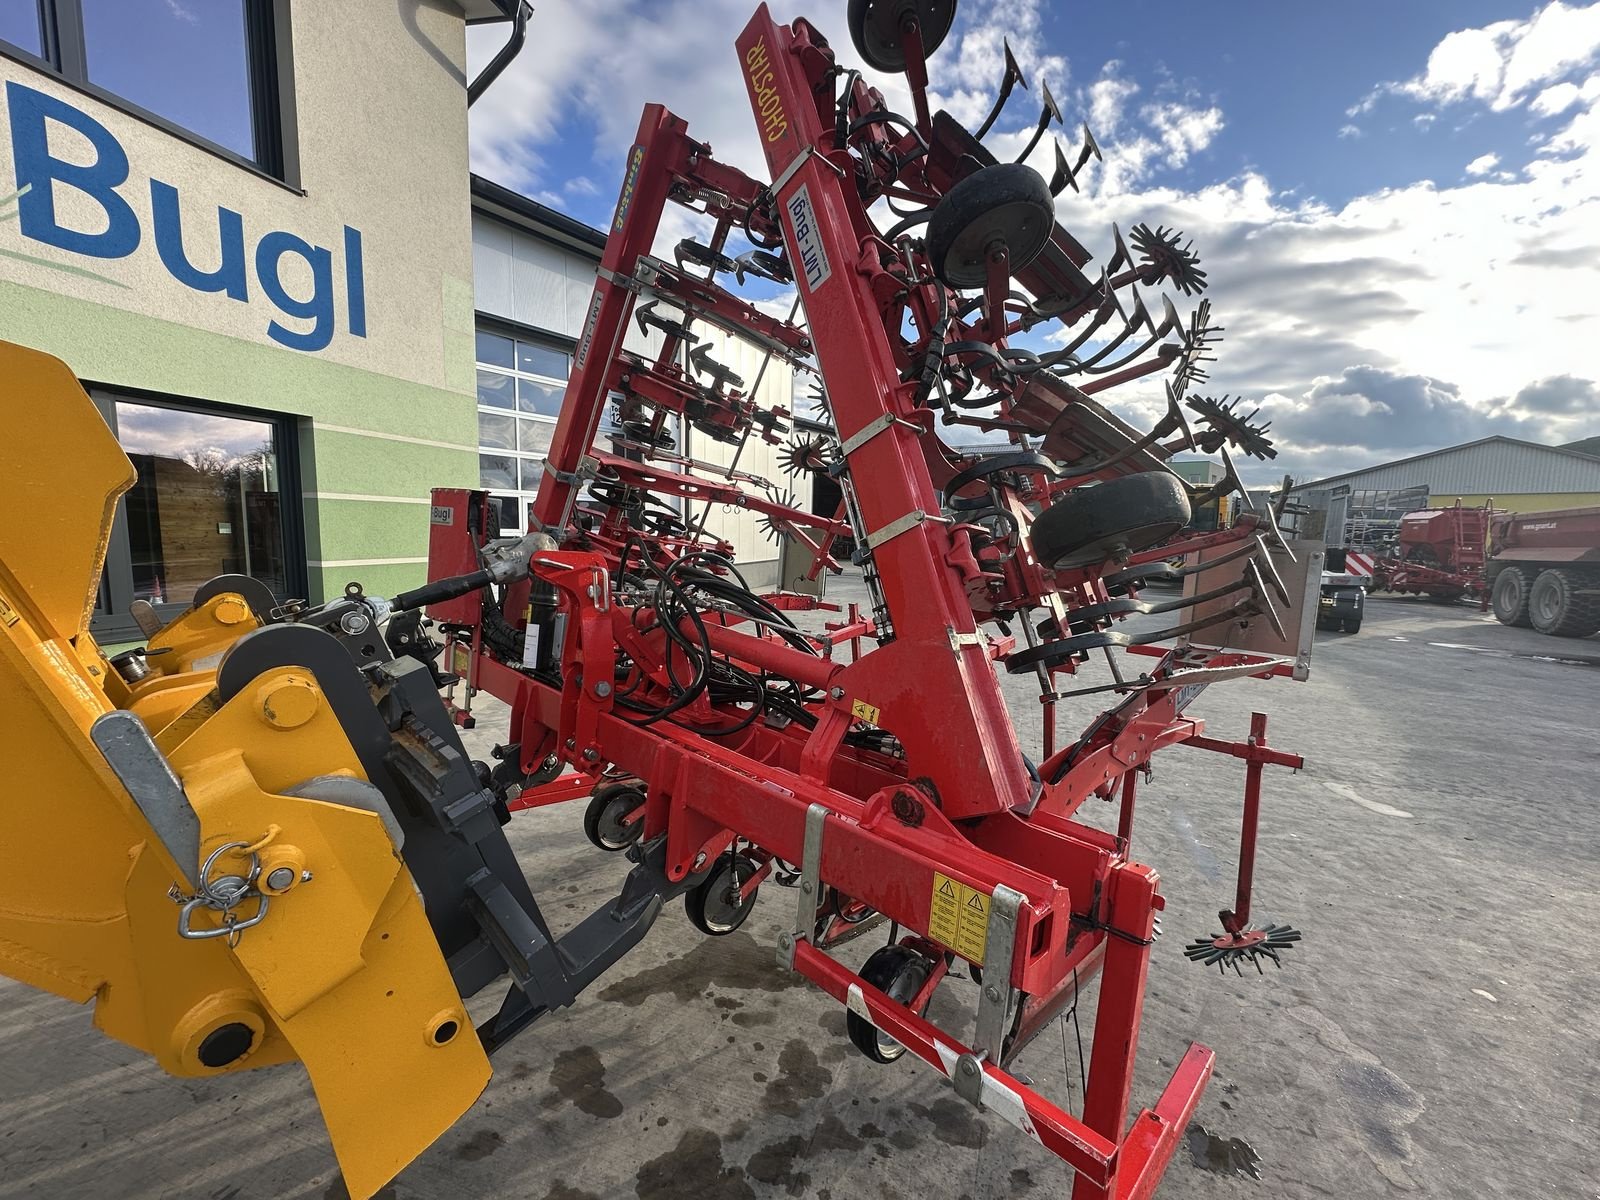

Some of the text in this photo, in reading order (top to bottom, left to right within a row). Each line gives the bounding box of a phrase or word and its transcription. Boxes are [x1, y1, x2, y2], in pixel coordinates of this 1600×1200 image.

[746, 34, 788, 142] CHOPSTAR
[6, 80, 367, 352] Bugl
[789, 196, 823, 287] LMT-Bugl
[579, 296, 602, 366] LMT-Bugl
[611, 412, 621, 423] 12
